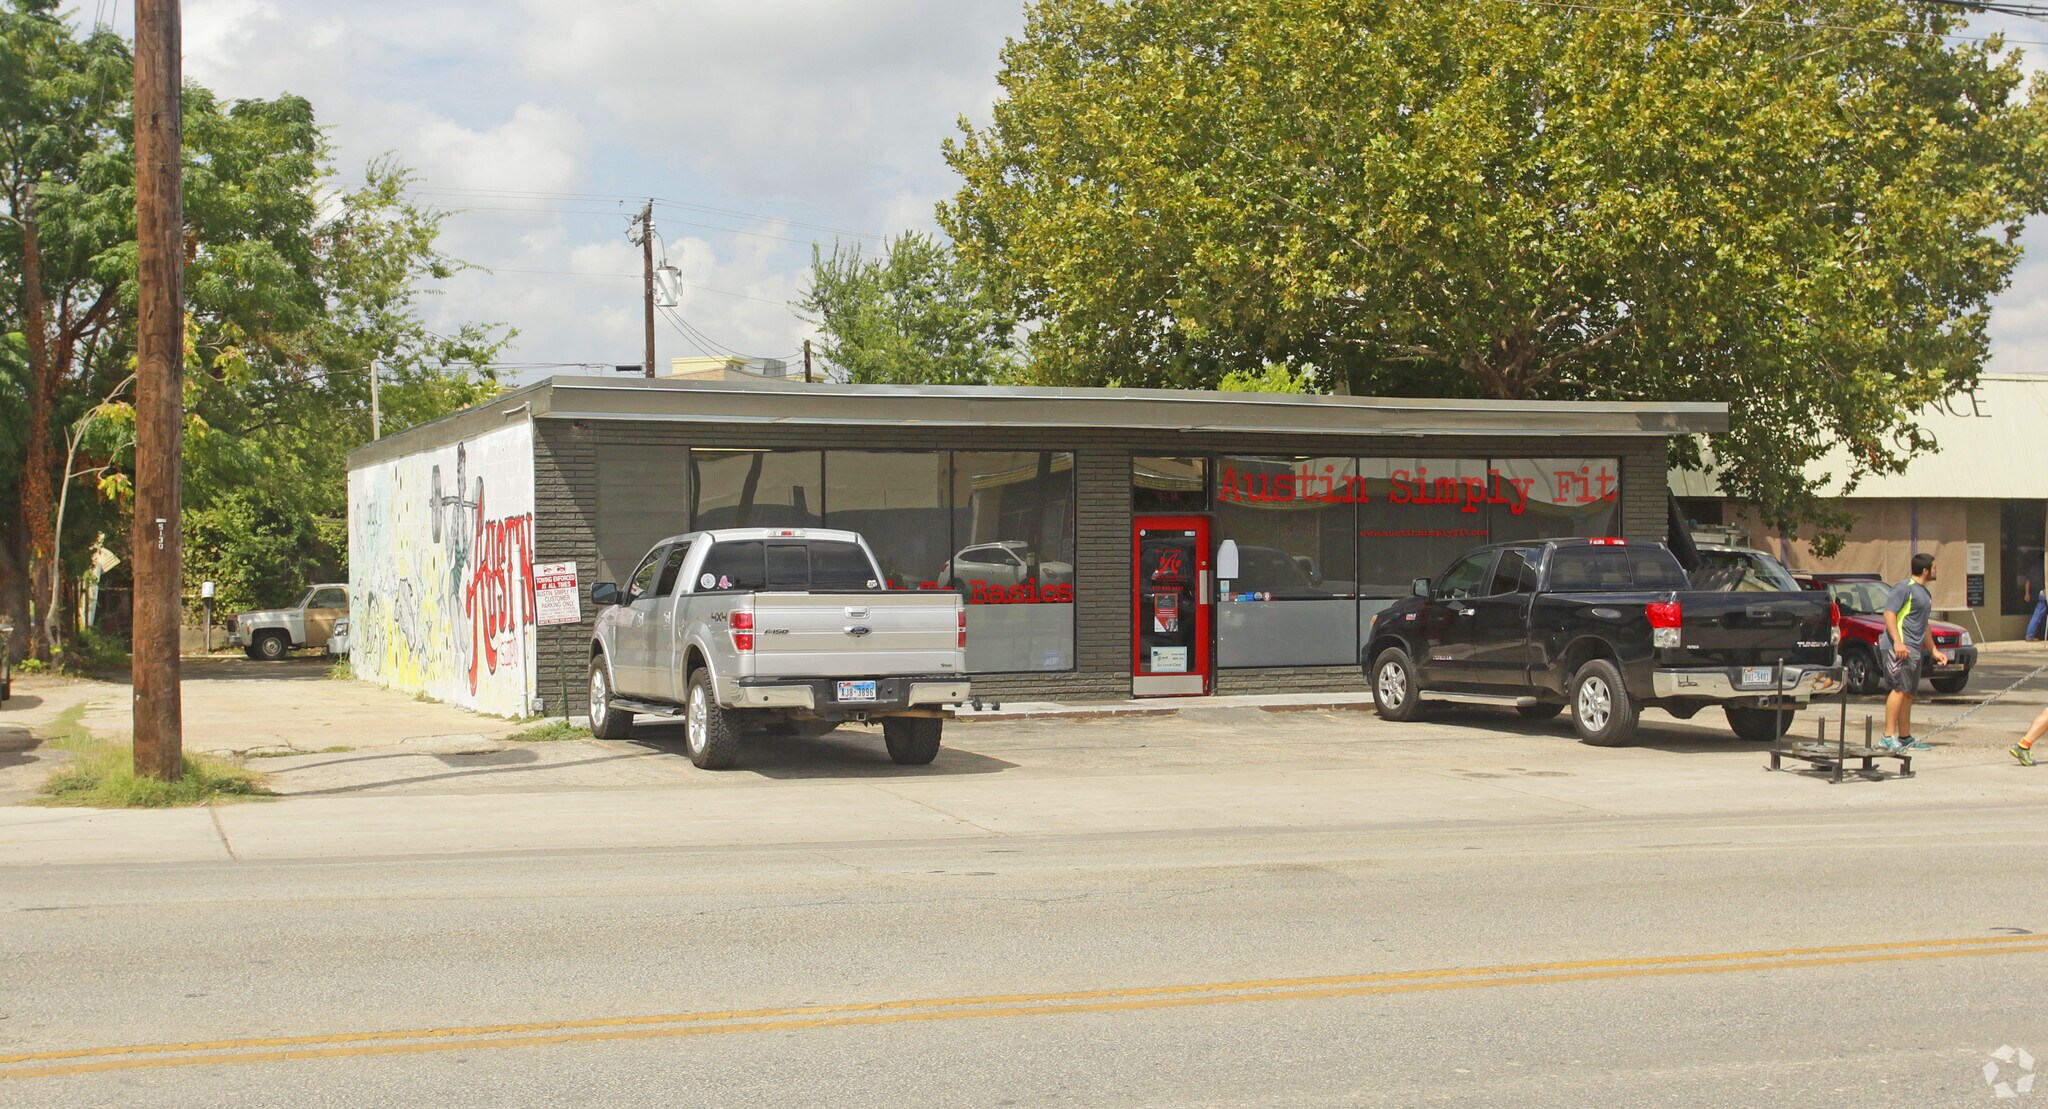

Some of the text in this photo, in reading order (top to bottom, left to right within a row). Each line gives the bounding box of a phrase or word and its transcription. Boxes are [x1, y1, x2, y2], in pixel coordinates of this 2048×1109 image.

[1217, 464, 1617, 515] Austin Simply Fit
[553, 574, 575, 582] ENFORCED
[557, 580, 571, 588] TIMES
[969, 577, 1073, 605] Basics
[466, 489, 534, 697] AUSTN
